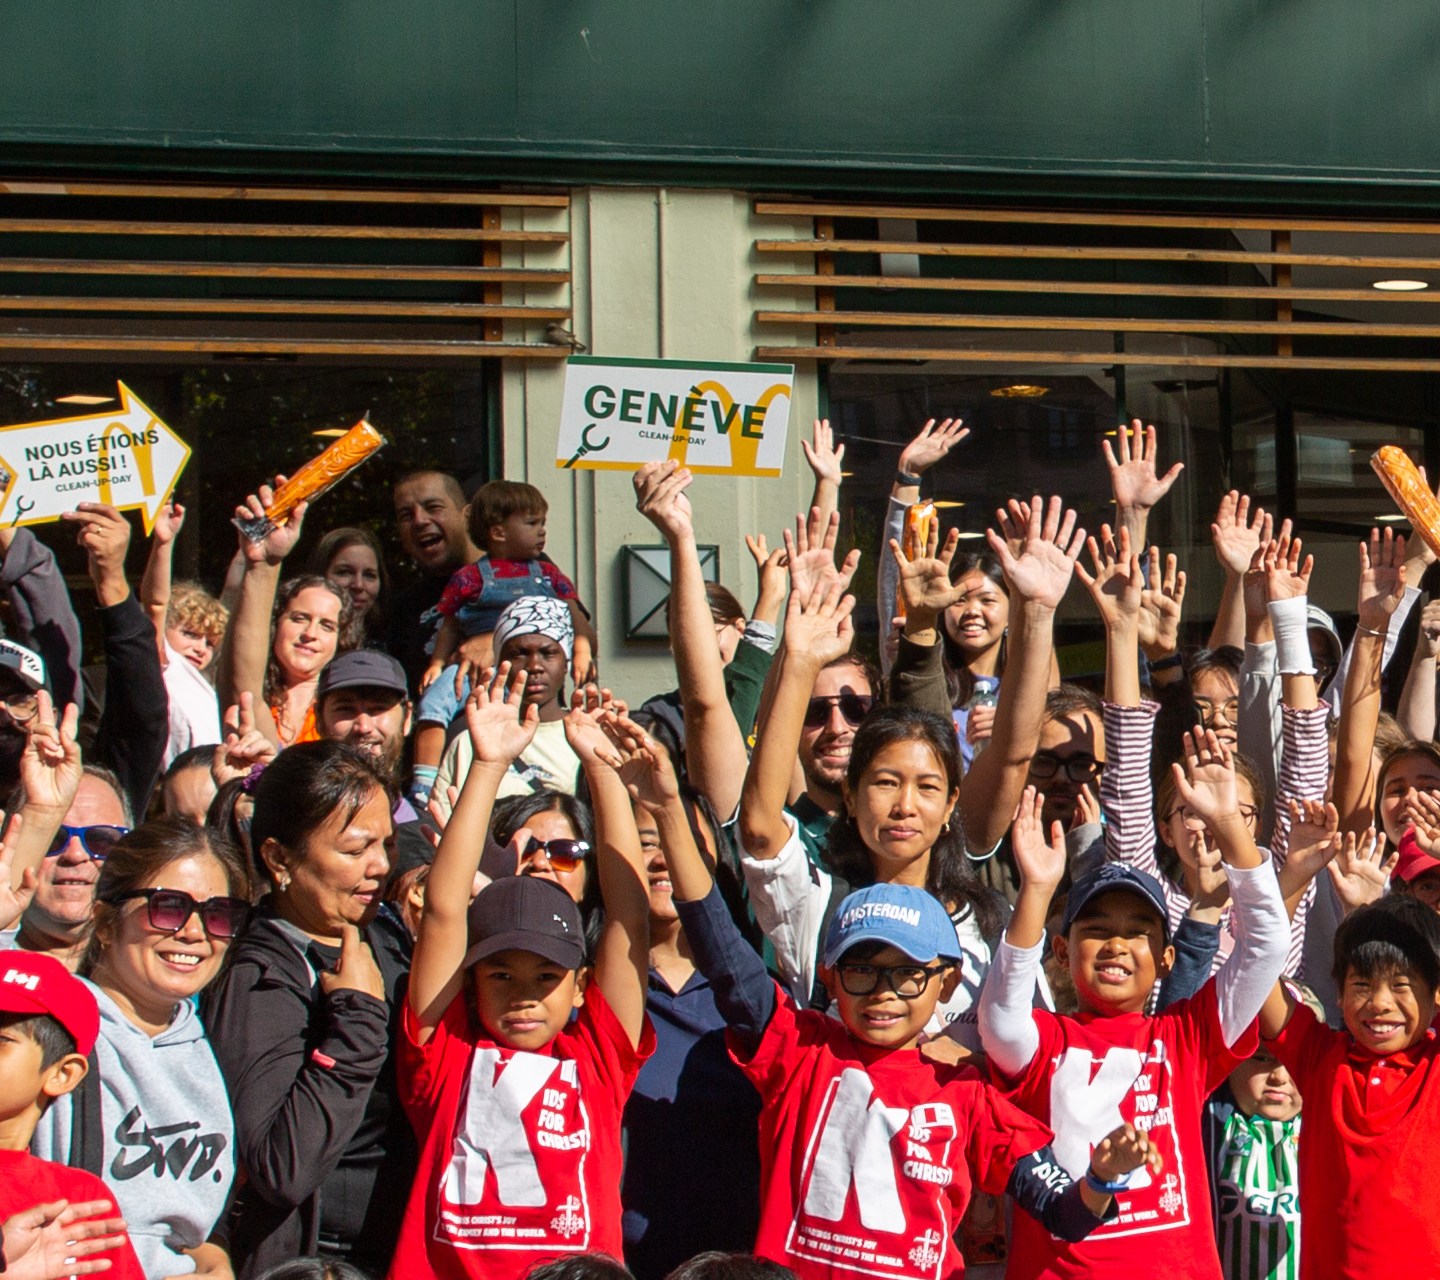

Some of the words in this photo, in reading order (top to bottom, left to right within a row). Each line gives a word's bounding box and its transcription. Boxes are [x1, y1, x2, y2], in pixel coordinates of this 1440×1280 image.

[584, 385, 767, 439] GENÈVE
[25, 440, 83, 462] NOUS
[86, 429, 160, 454] ÉTIONS
[638, 429, 707, 446] CLEAN-UP-DAY
[28, 461, 54, 482] LÀ
[59, 457, 117, 478] AUSSI
[55, 474, 132, 493] CLEAN-UP-DAY
[542, 1088, 568, 1110] IDS
[537, 1108, 565, 1132] FOR
[536, 1129, 587, 1151] CHRIST
[1245, 1192, 1301, 1217] GR
